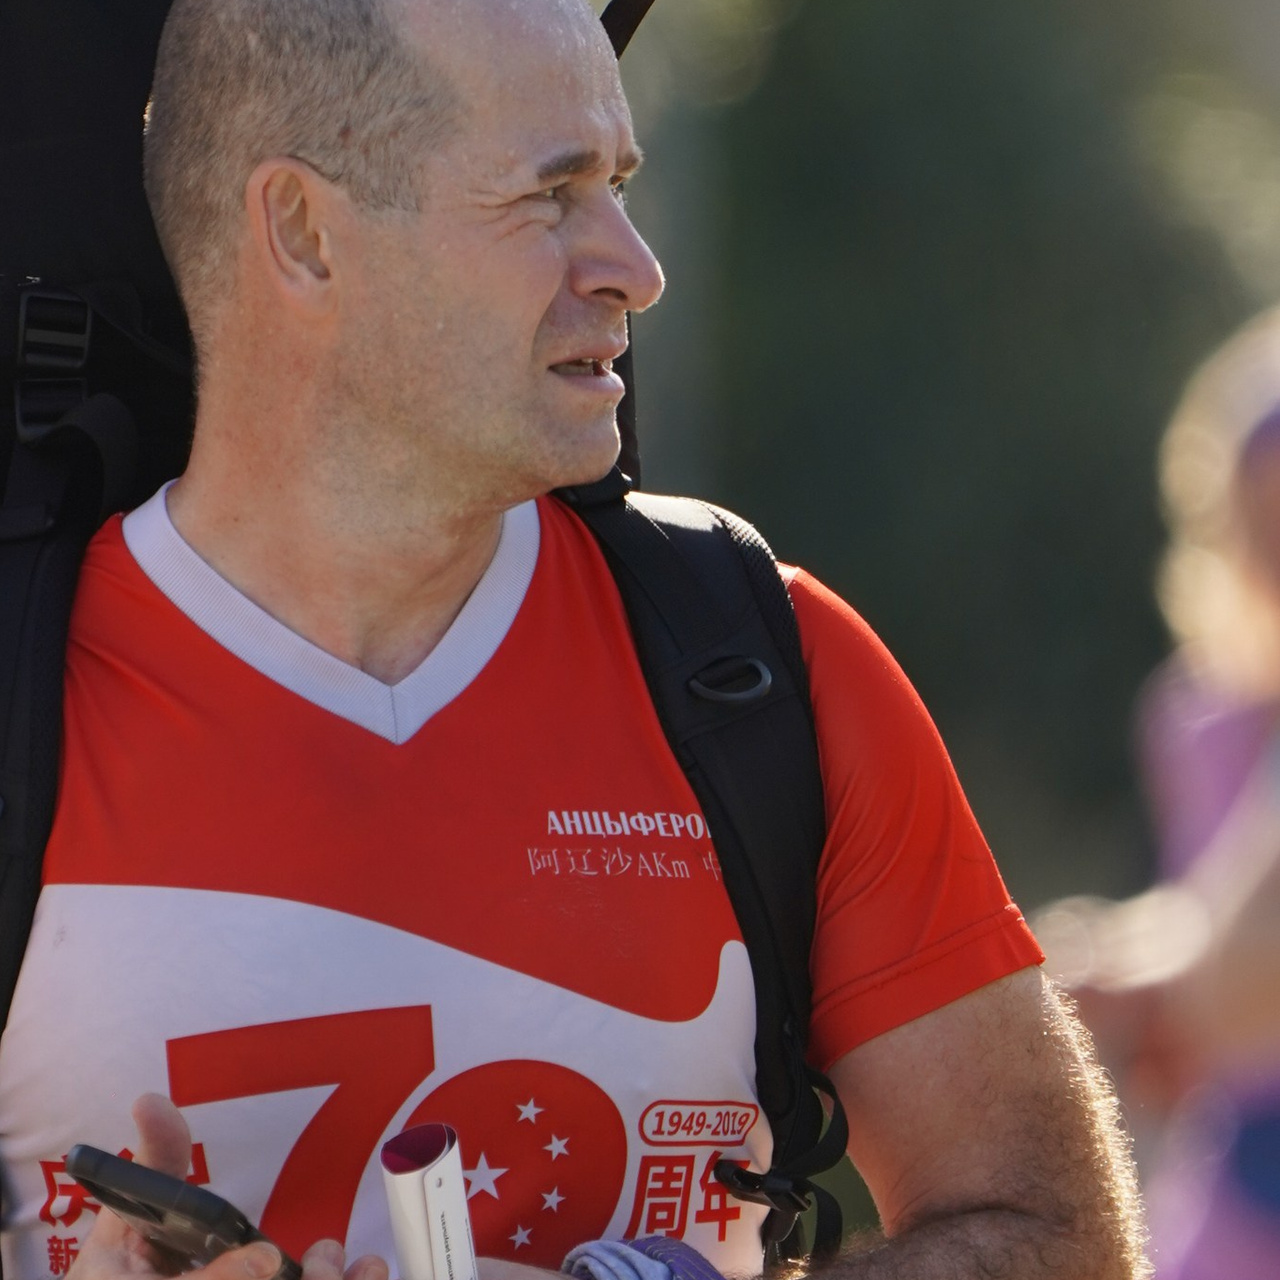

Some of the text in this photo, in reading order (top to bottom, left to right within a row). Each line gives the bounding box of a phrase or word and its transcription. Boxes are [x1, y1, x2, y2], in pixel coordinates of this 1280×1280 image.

[547, 810, 712, 839] АНЦЫФЕРО
[651, 1109, 751, 1137] 1949-2019
[622, 1149, 752, 1243] 周年
